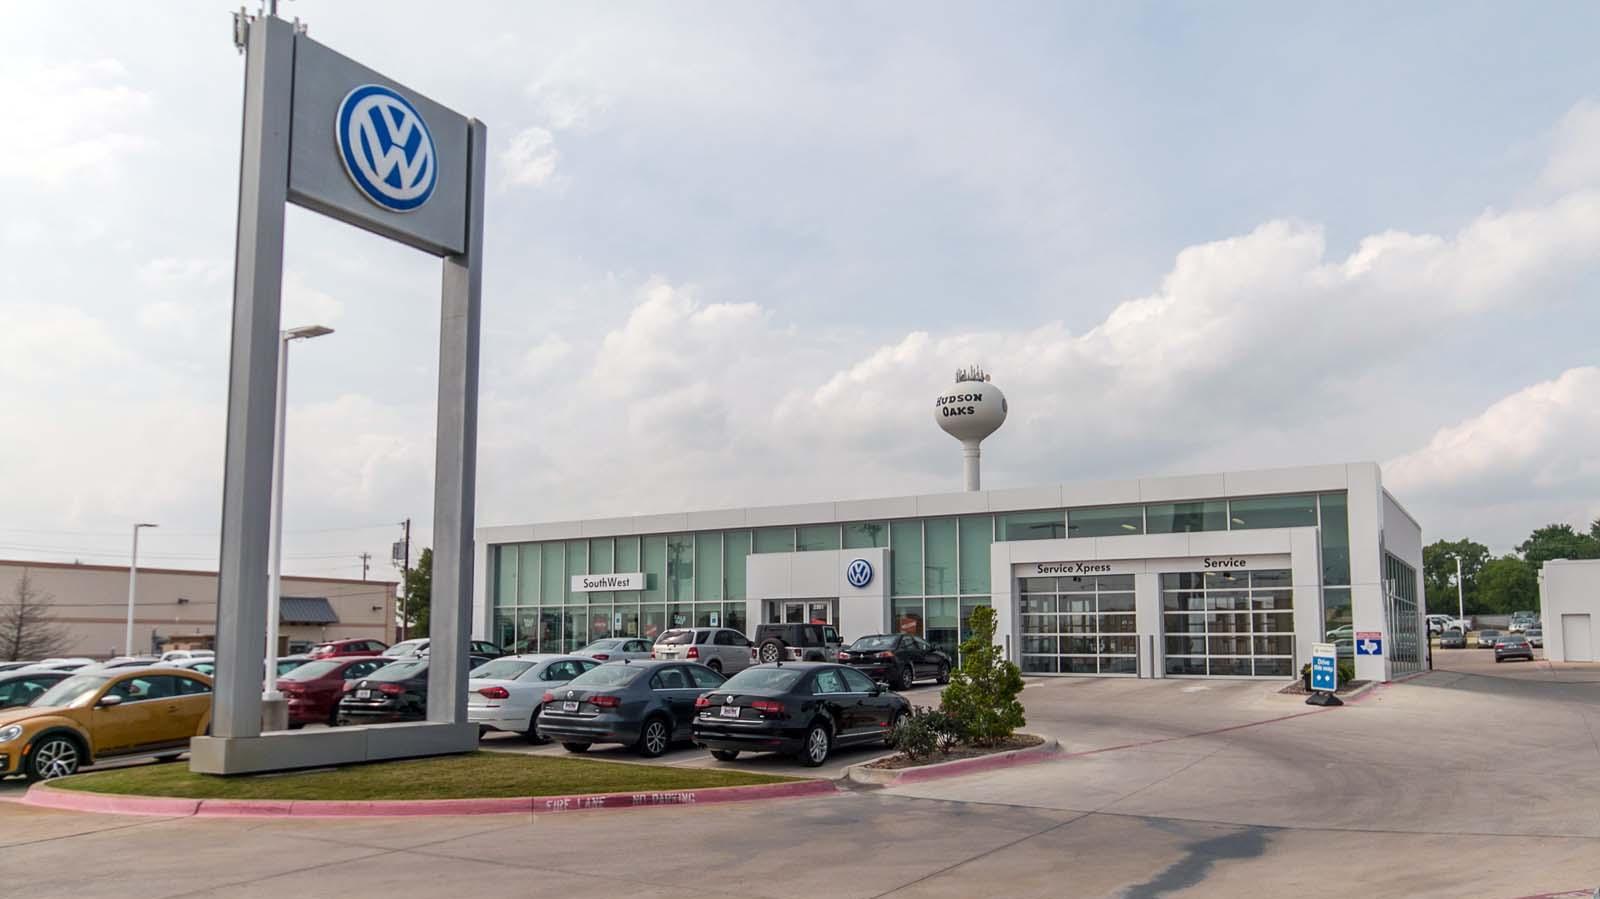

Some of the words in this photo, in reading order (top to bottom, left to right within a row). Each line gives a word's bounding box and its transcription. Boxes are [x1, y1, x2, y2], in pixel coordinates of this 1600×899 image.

[345, 92, 435, 203] VW
[936, 393, 983, 407] HUDSON
[942, 406, 975, 417] OAKS
[1037, 563, 1074, 574] Service
[1075, 562, 1111, 575] Xpress
[1204, 557, 1247, 568] Service
[583, 577, 630, 589] SouthWest
[632, 794, 646, 805] NO
